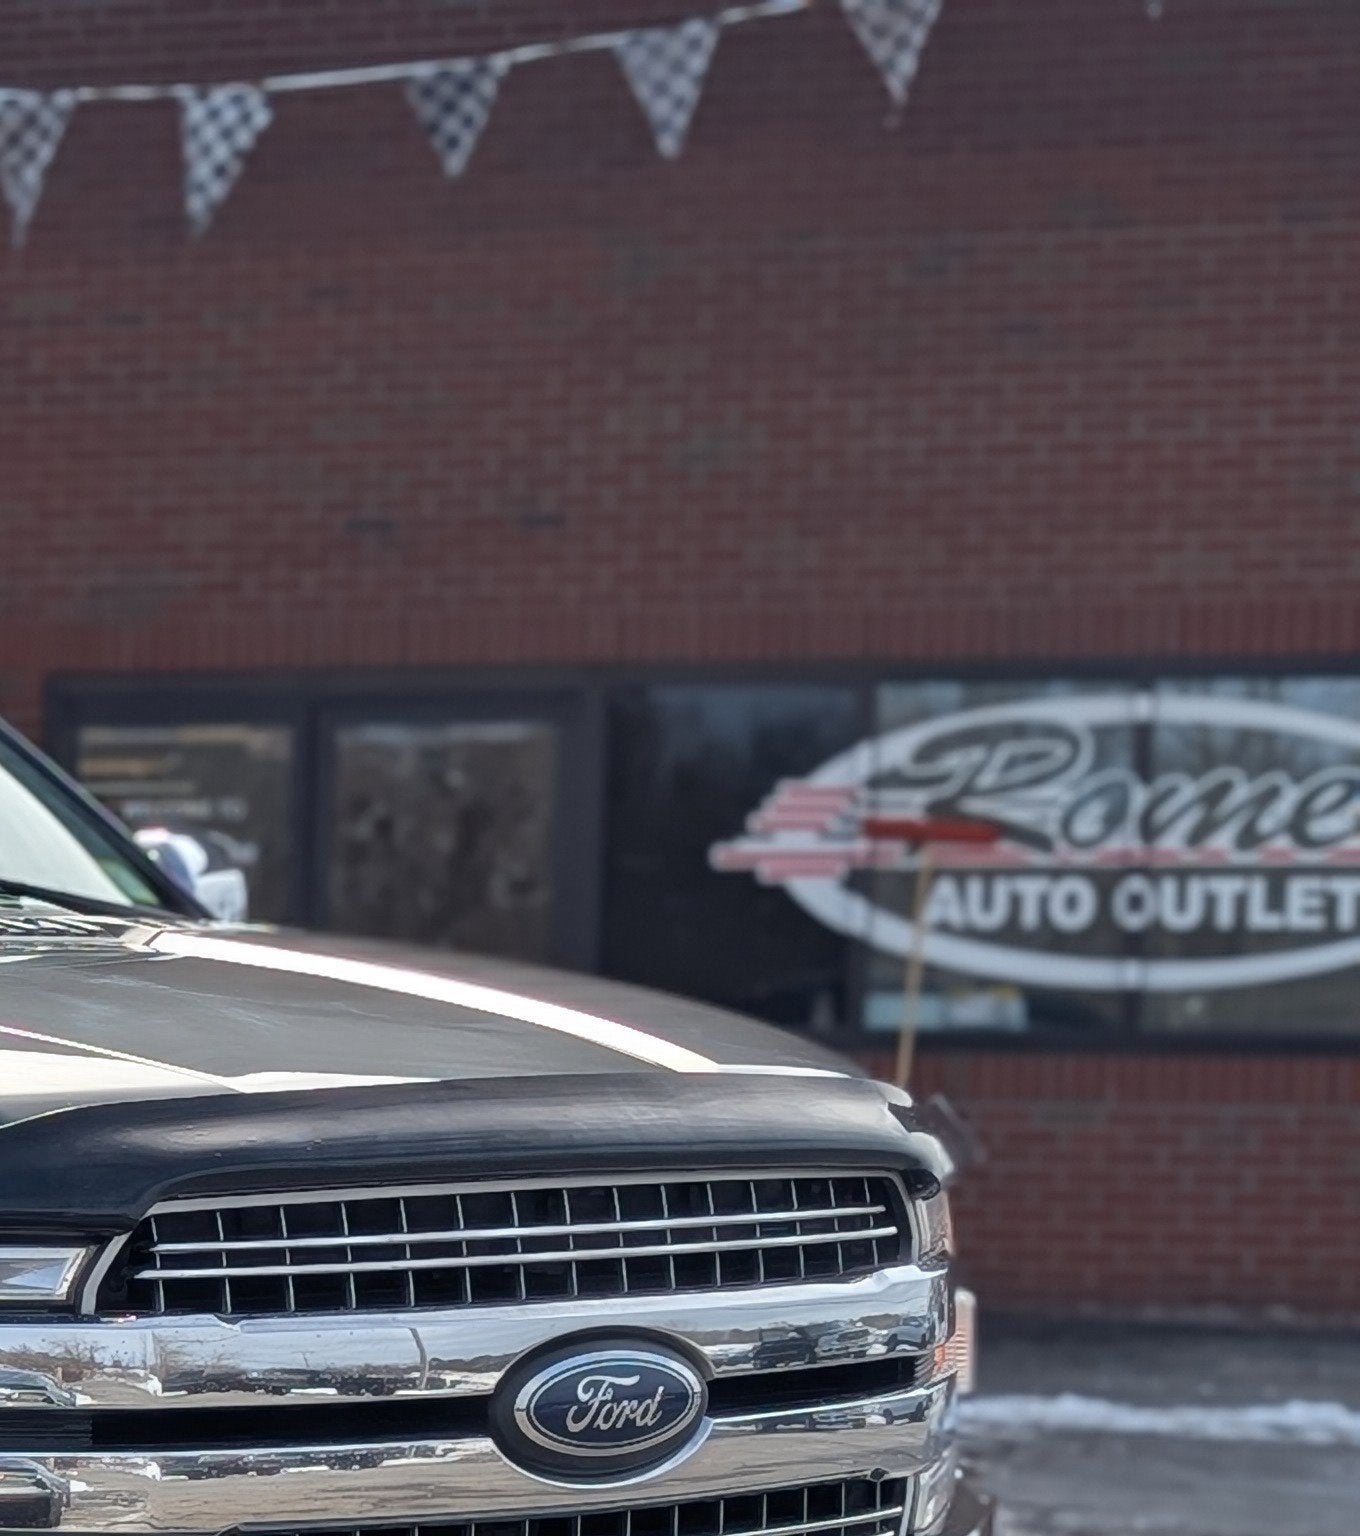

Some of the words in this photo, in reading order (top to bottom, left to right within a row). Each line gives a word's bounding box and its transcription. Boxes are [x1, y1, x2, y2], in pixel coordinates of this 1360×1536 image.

[872, 716, 1360, 852] Rome
[927, 875, 1097, 931] AUTO
[1114, 874, 1360, 931] OUTLET
[566, 1374, 664, 1433] Ford
